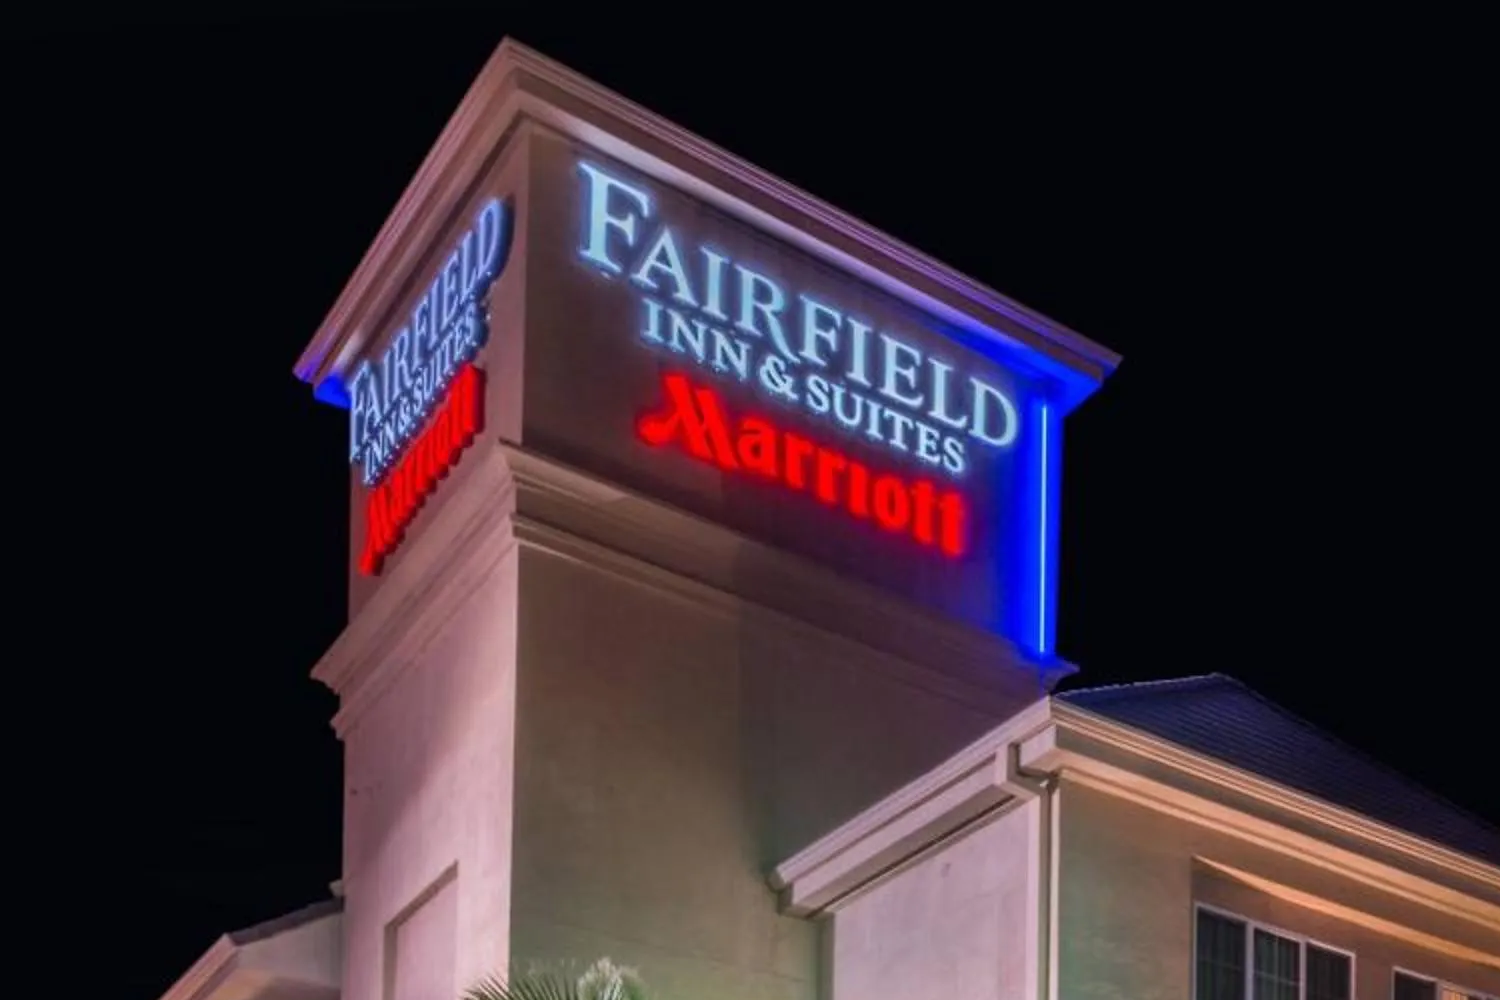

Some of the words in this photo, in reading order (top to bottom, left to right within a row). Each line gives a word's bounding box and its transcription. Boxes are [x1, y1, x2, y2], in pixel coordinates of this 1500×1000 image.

[350, 198, 504, 463] FAIRFIELD
[362, 417, 399, 486] INN
[412, 303, 478, 412] SUITES
[577, 161, 1018, 449] FAIRFIELD
[643, 297, 750, 380] INN
[759, 360, 800, 402] &
[806, 377, 966, 474] SUITES
[638, 372, 966, 557] Marriott
